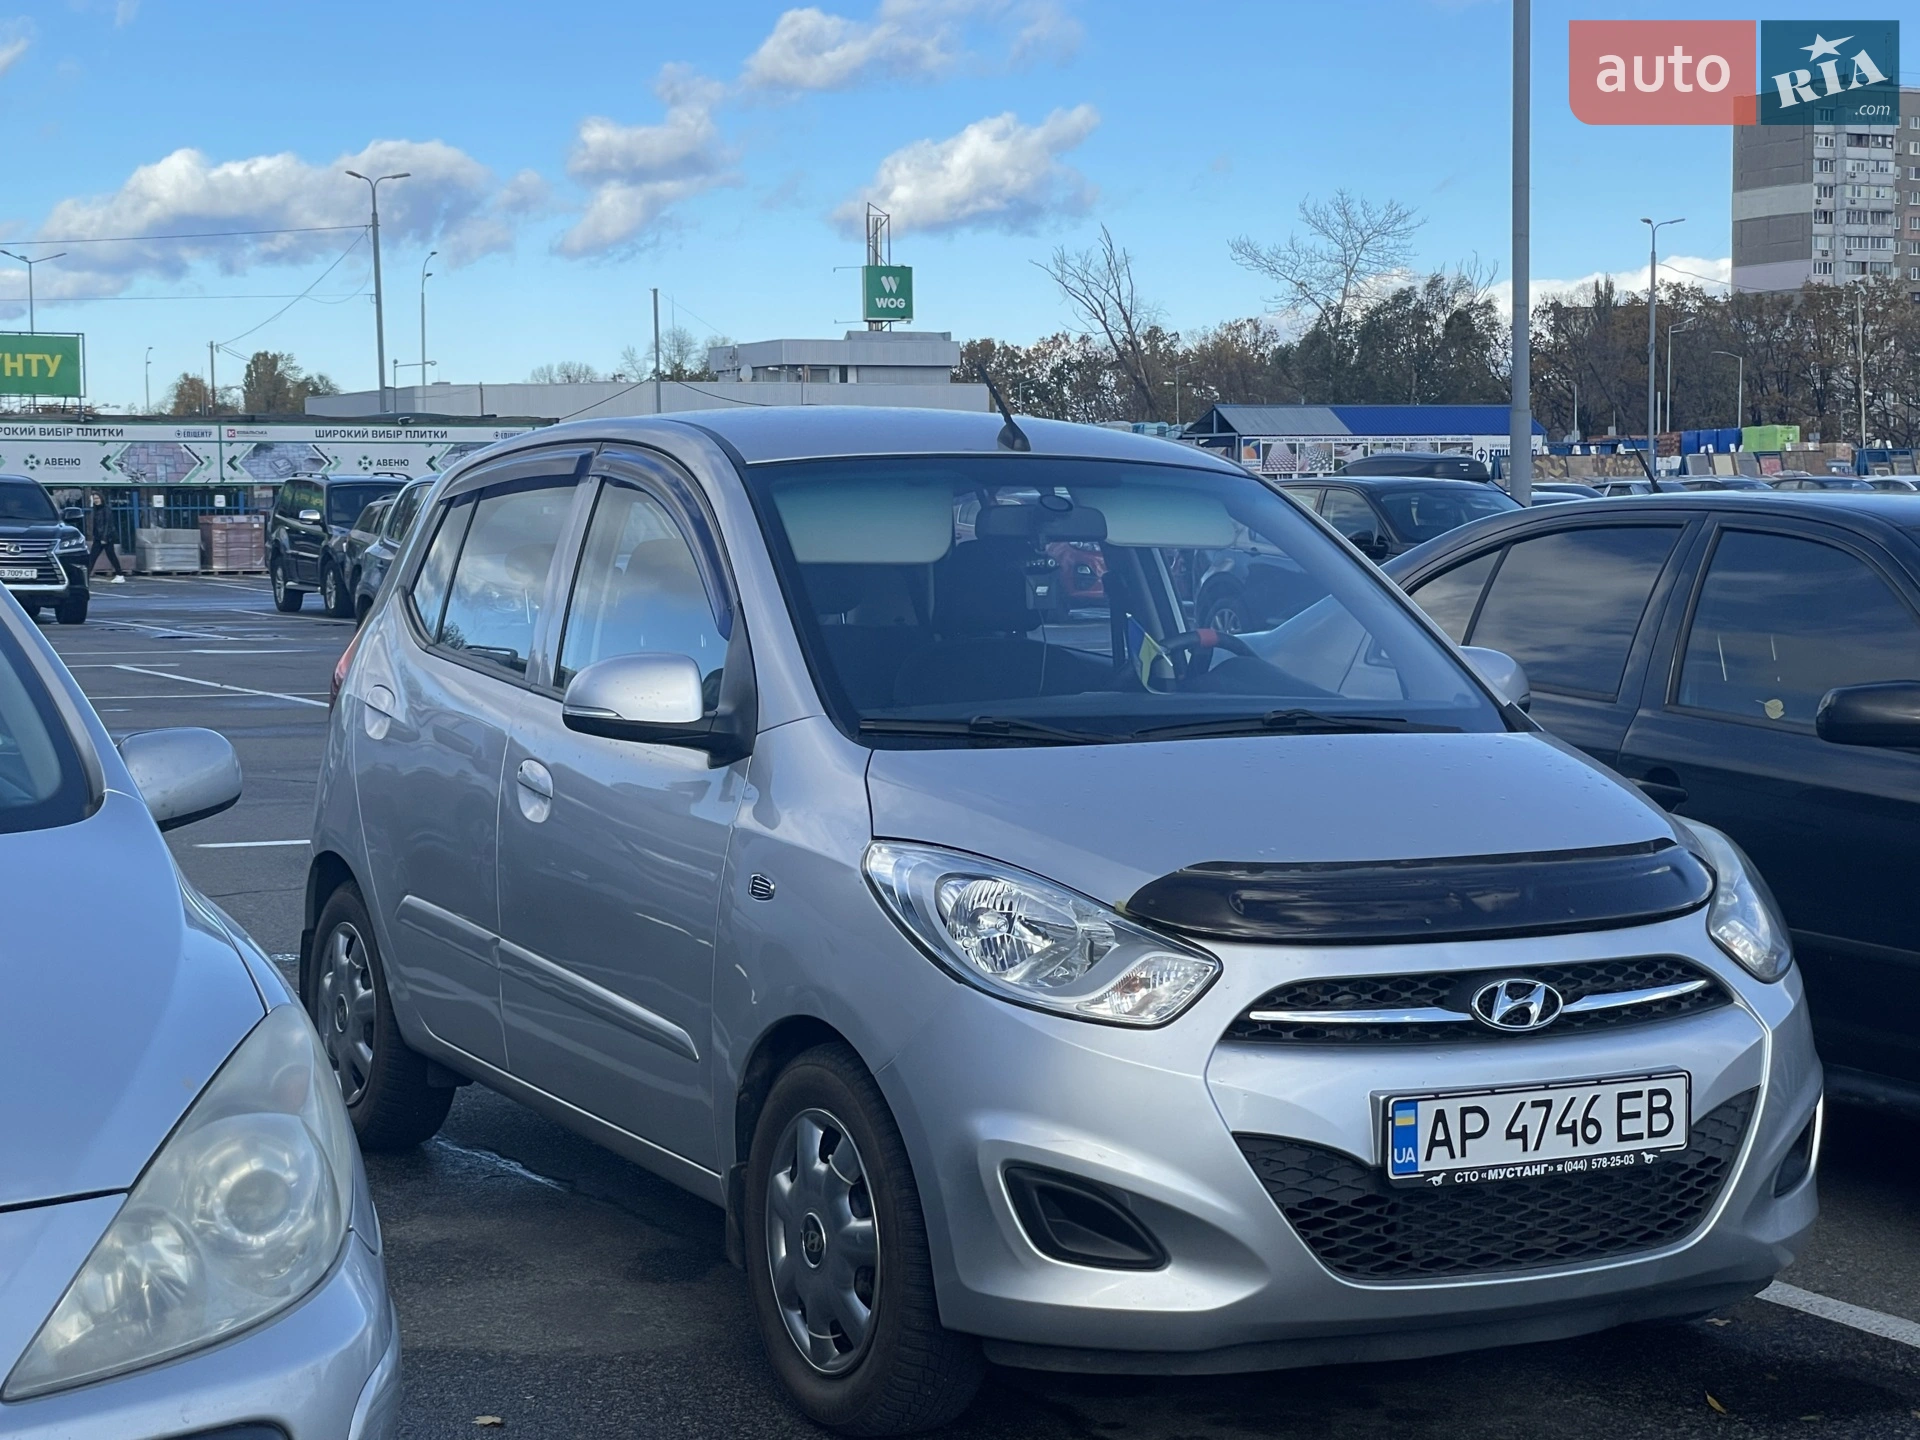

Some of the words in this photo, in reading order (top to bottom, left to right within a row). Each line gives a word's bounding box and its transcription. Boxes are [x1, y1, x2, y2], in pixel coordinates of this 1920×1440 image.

[875, 297, 906, 309] WOG
[0, 353, 62, 377] НТУ
[39, 427, 73, 437] ВИБІР
[76, 428, 124, 437] ПЛИТКИ
[315, 428, 369, 438] ШИРОКИЙ
[371, 430, 403, 439] ВИБІР
[405, 430, 448, 439] ПЛИТКИ
[44, 457, 81, 466] АВЕНЮ
[376, 459, 409, 467] АВЕНЮ
[1424, 1106, 1490, 1162] AP
[1504, 1094, 1602, 1153] 4746
[1616, 1087, 1674, 1143] EB
[1393, 1147, 1416, 1164] UA
[1454, 1170, 1479, 1184] СТО
[1481, 1163, 1554, 1181] «МУСТАНГ»
[1564, 1158, 1588, 1174] (044)
[1591, 1153, 1635, 1170] 578-25-03
